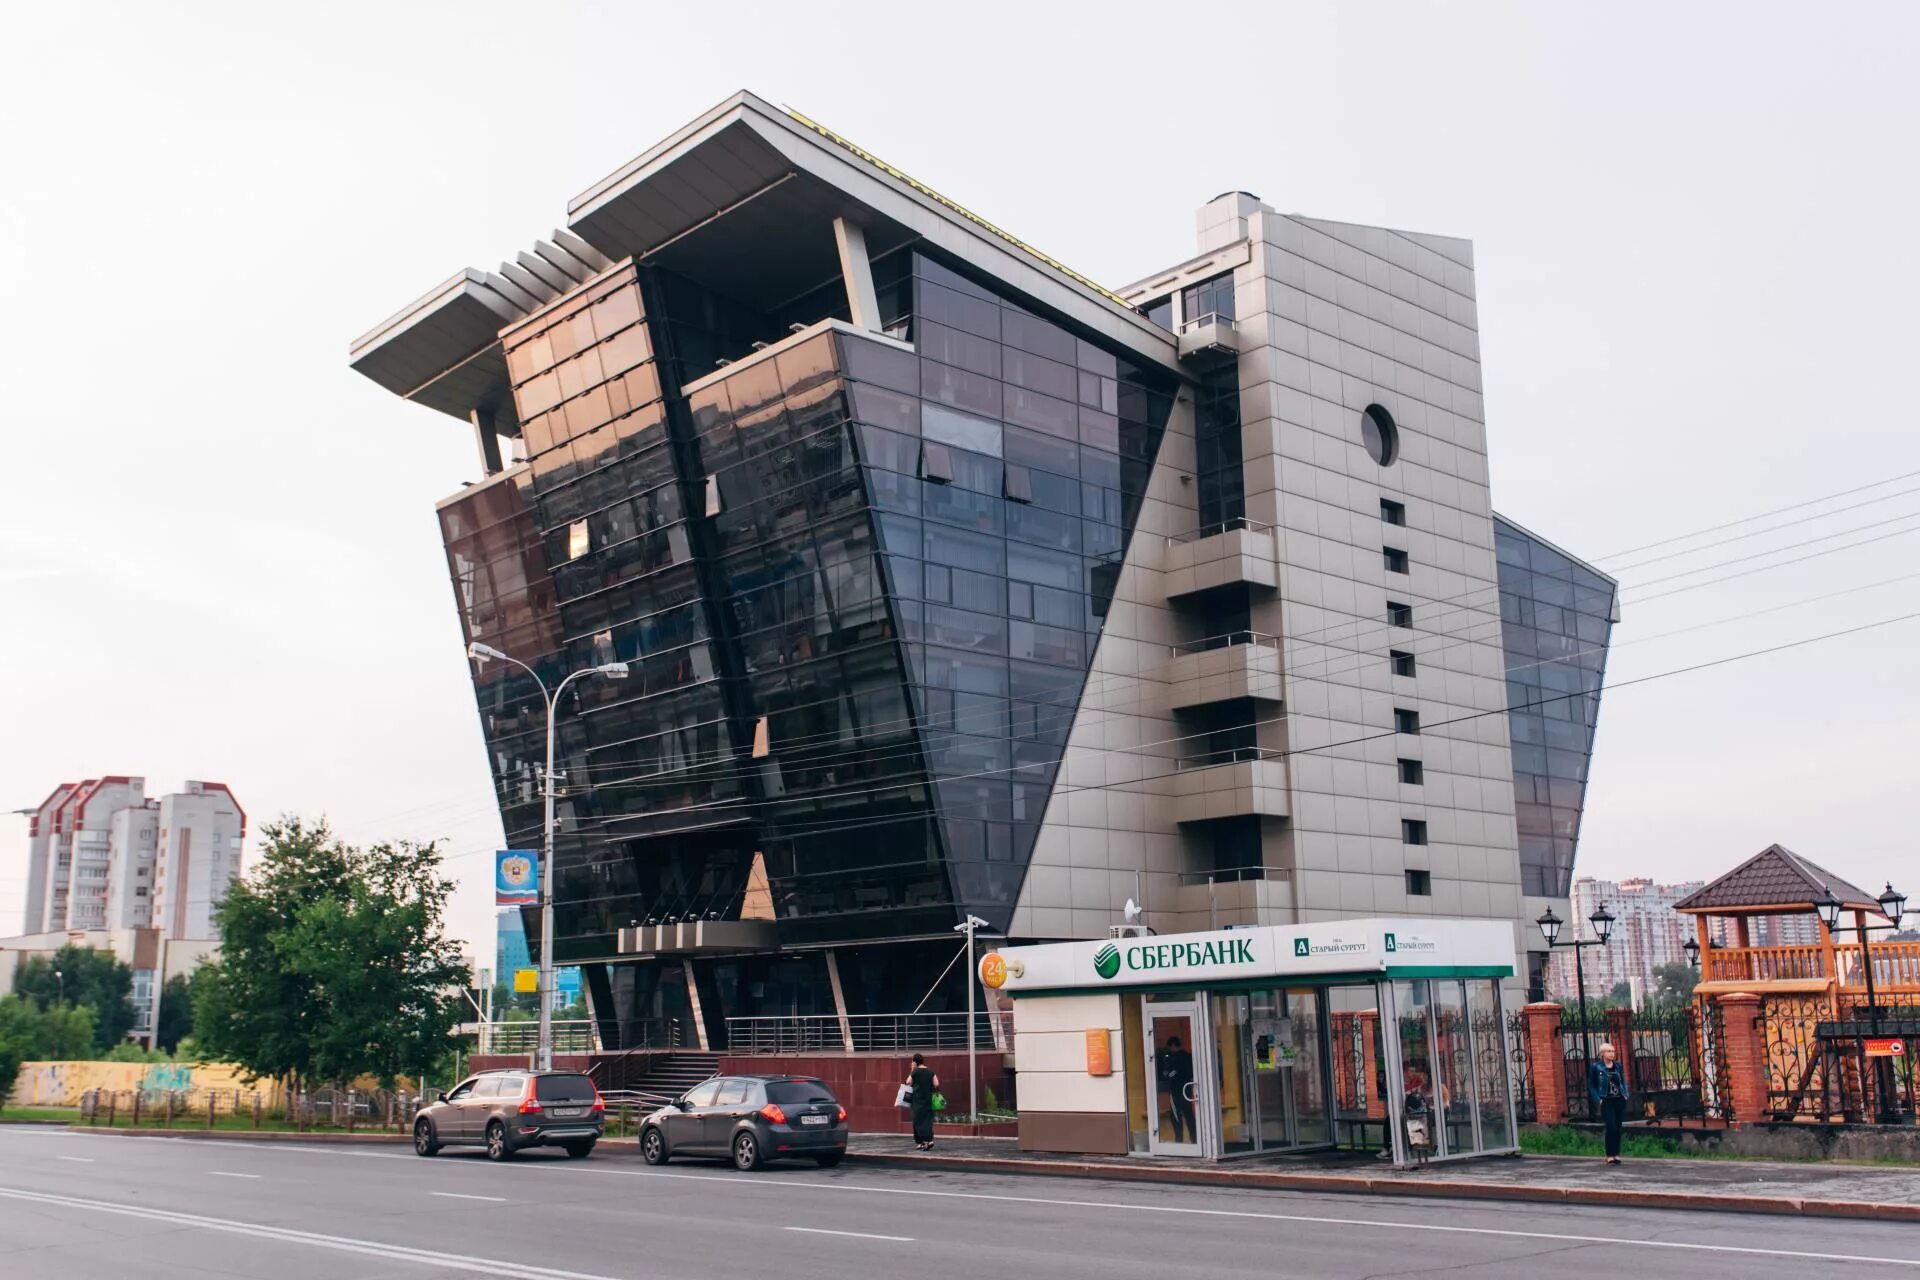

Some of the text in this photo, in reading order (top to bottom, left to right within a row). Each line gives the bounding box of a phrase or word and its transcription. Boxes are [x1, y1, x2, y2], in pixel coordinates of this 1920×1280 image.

[1127, 938, 1256, 970] СБЕРБАНК
[1310, 944, 1340, 953] СТАРЫЙ
[1340, 943, 1367, 952] СУРГУТ
[986, 961, 1004, 976] 24
